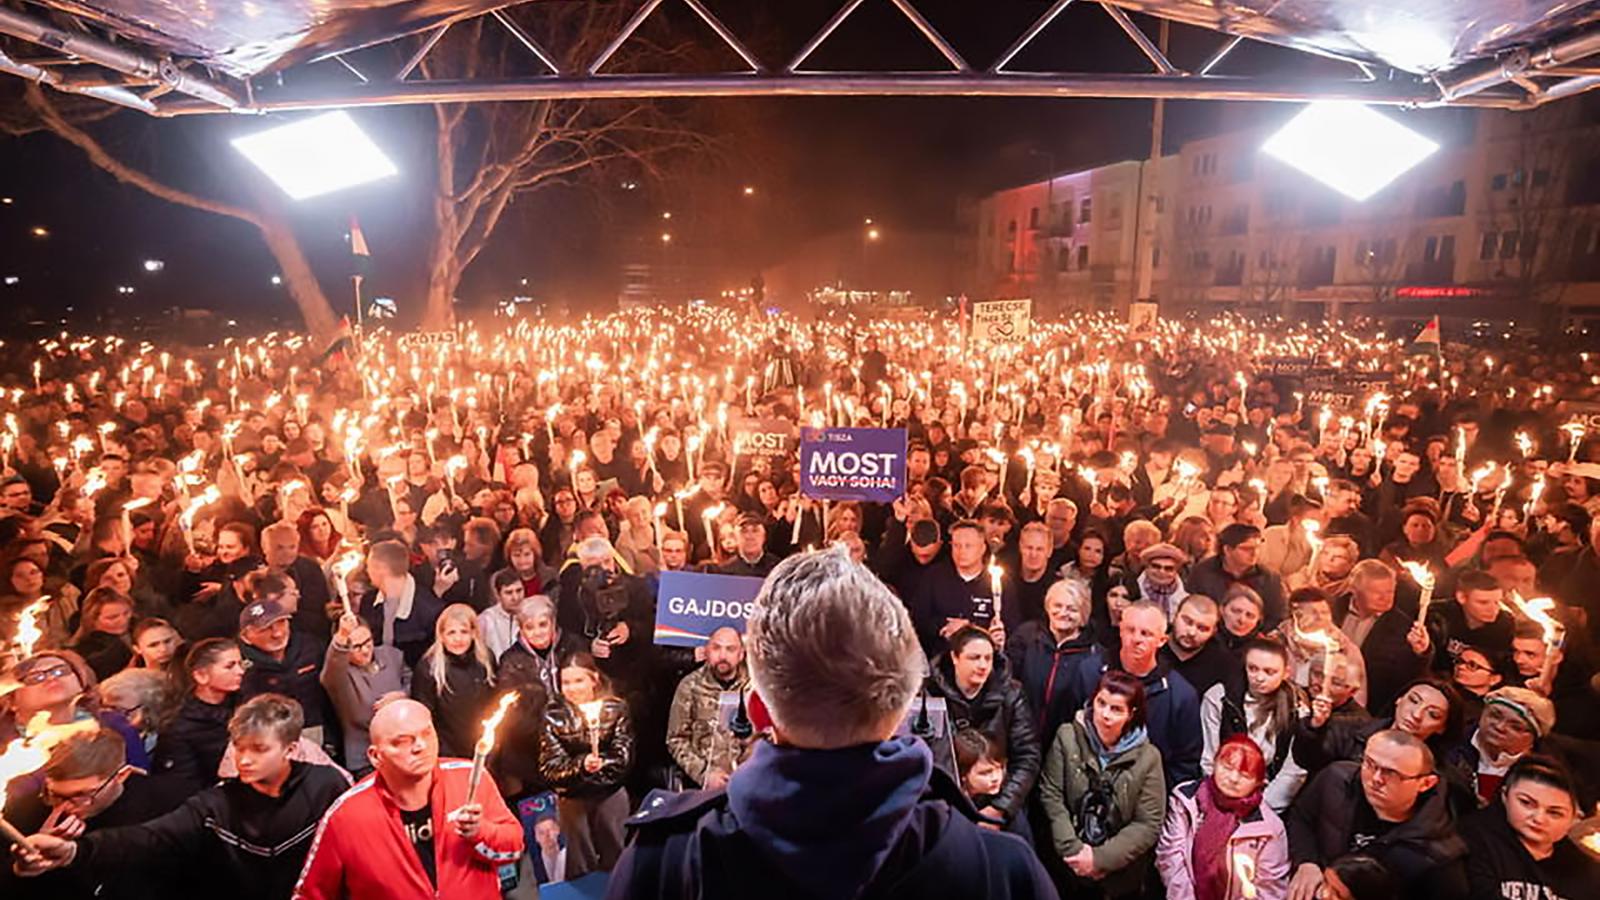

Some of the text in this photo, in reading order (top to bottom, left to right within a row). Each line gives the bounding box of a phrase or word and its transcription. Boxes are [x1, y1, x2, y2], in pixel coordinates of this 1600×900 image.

[1308, 390, 1354, 406] MOST
[734, 431, 788, 448] MOST
[827, 433, 853, 442] TISZA
[809, 451, 898, 476] MOST
[808, 474, 897, 489] VAGY SOHA!
[668, 597, 754, 619] GAJDOS
